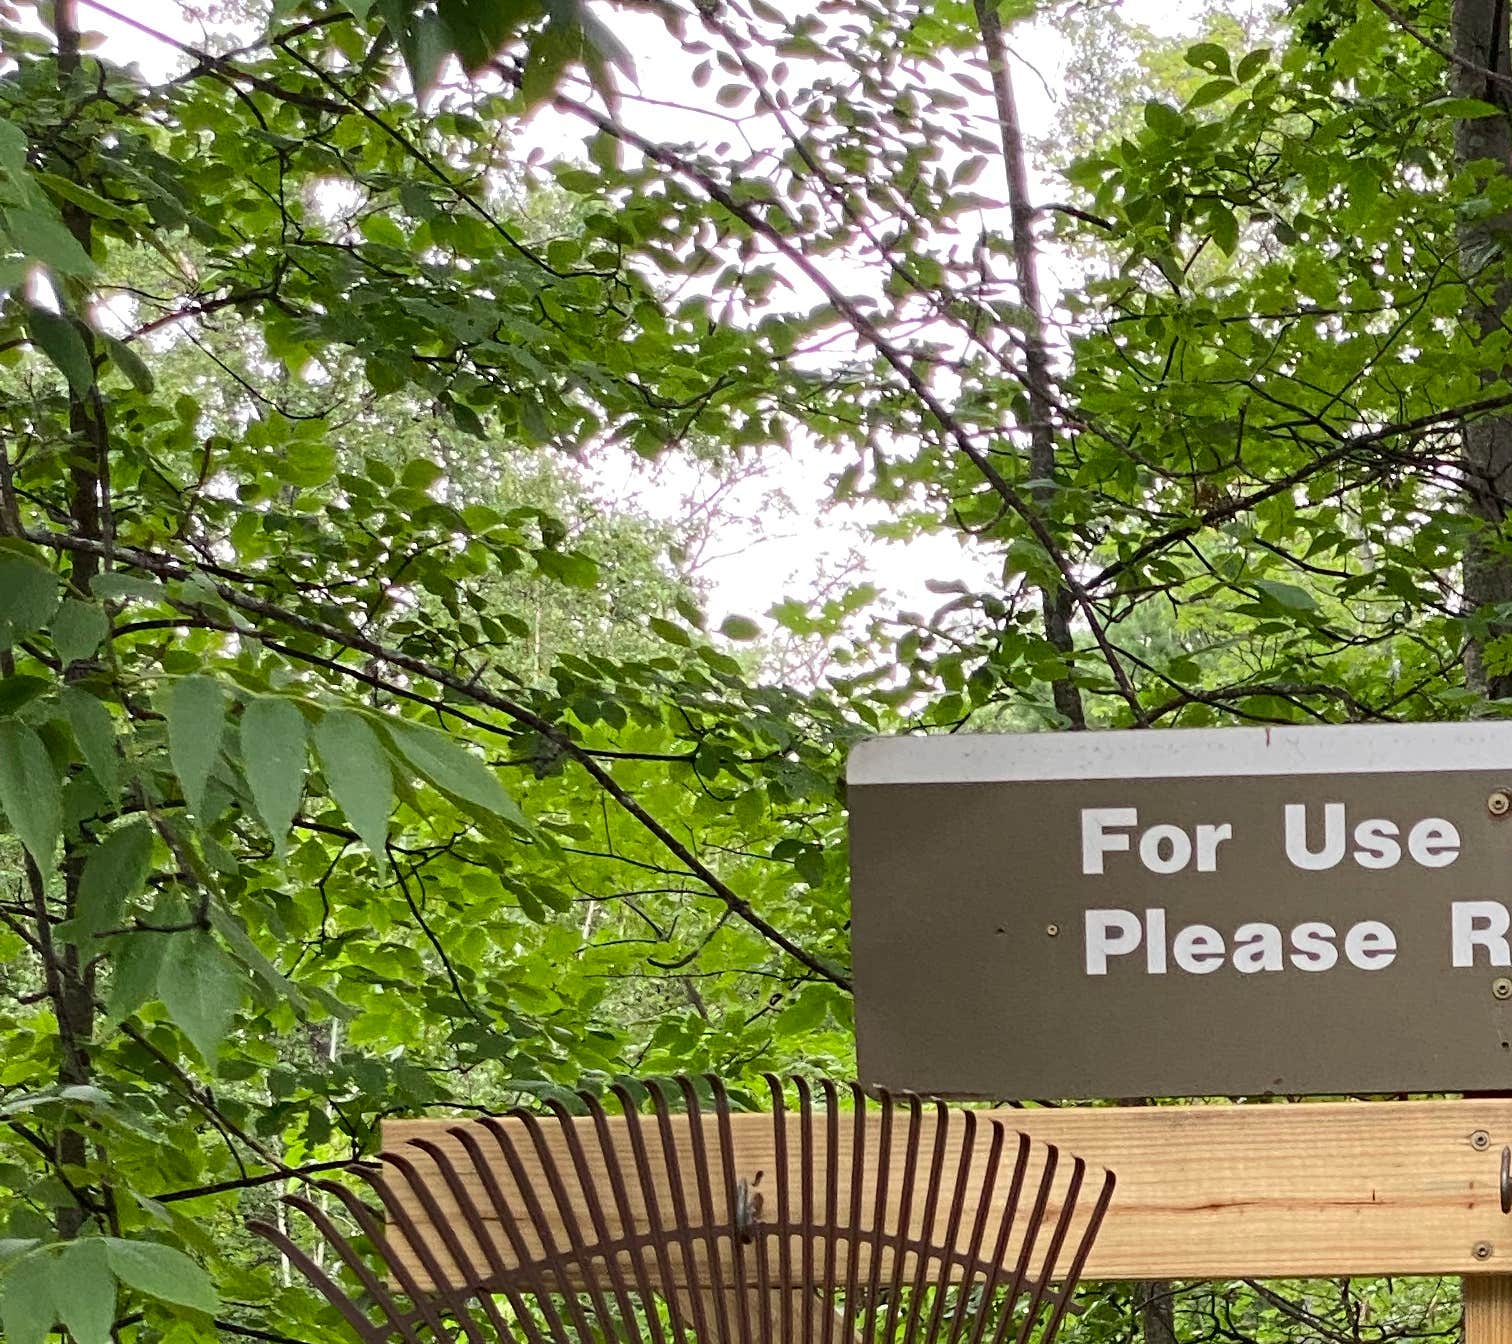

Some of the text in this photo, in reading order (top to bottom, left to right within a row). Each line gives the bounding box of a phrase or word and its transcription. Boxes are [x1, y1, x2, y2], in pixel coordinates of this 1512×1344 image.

[1081, 807, 1233, 874] For
[1284, 803, 1462, 870] Use
[1085, 908, 1398, 975] Please
